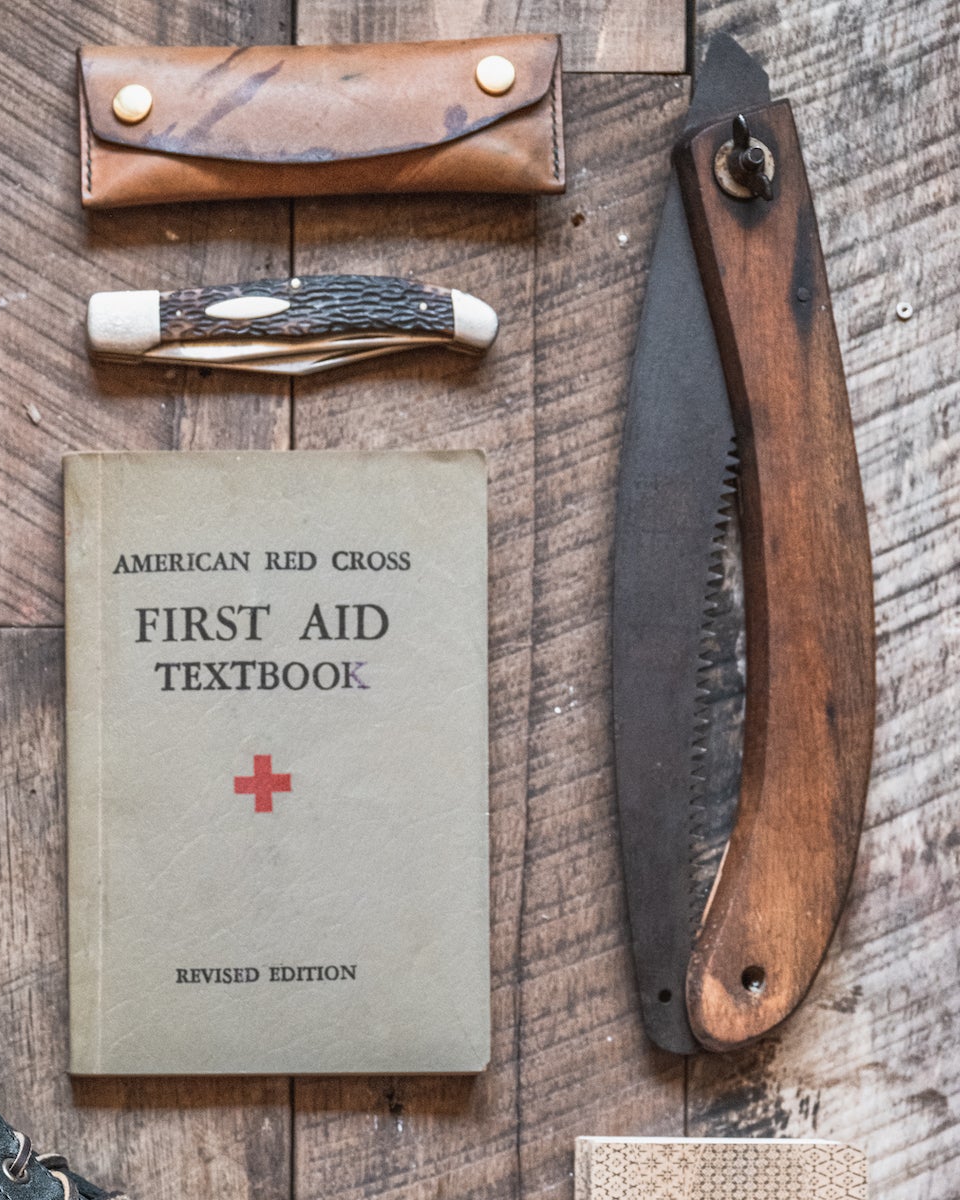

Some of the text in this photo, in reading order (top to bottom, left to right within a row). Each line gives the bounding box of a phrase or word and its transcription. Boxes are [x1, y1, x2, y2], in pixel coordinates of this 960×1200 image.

[112, 551, 411, 575] AMERICAN RED CROSS
[135, 603, 390, 644] FIRST AID
[154, 660, 371, 692] TEXTBOOK
[175, 964, 357, 985] REVISED EDITION
